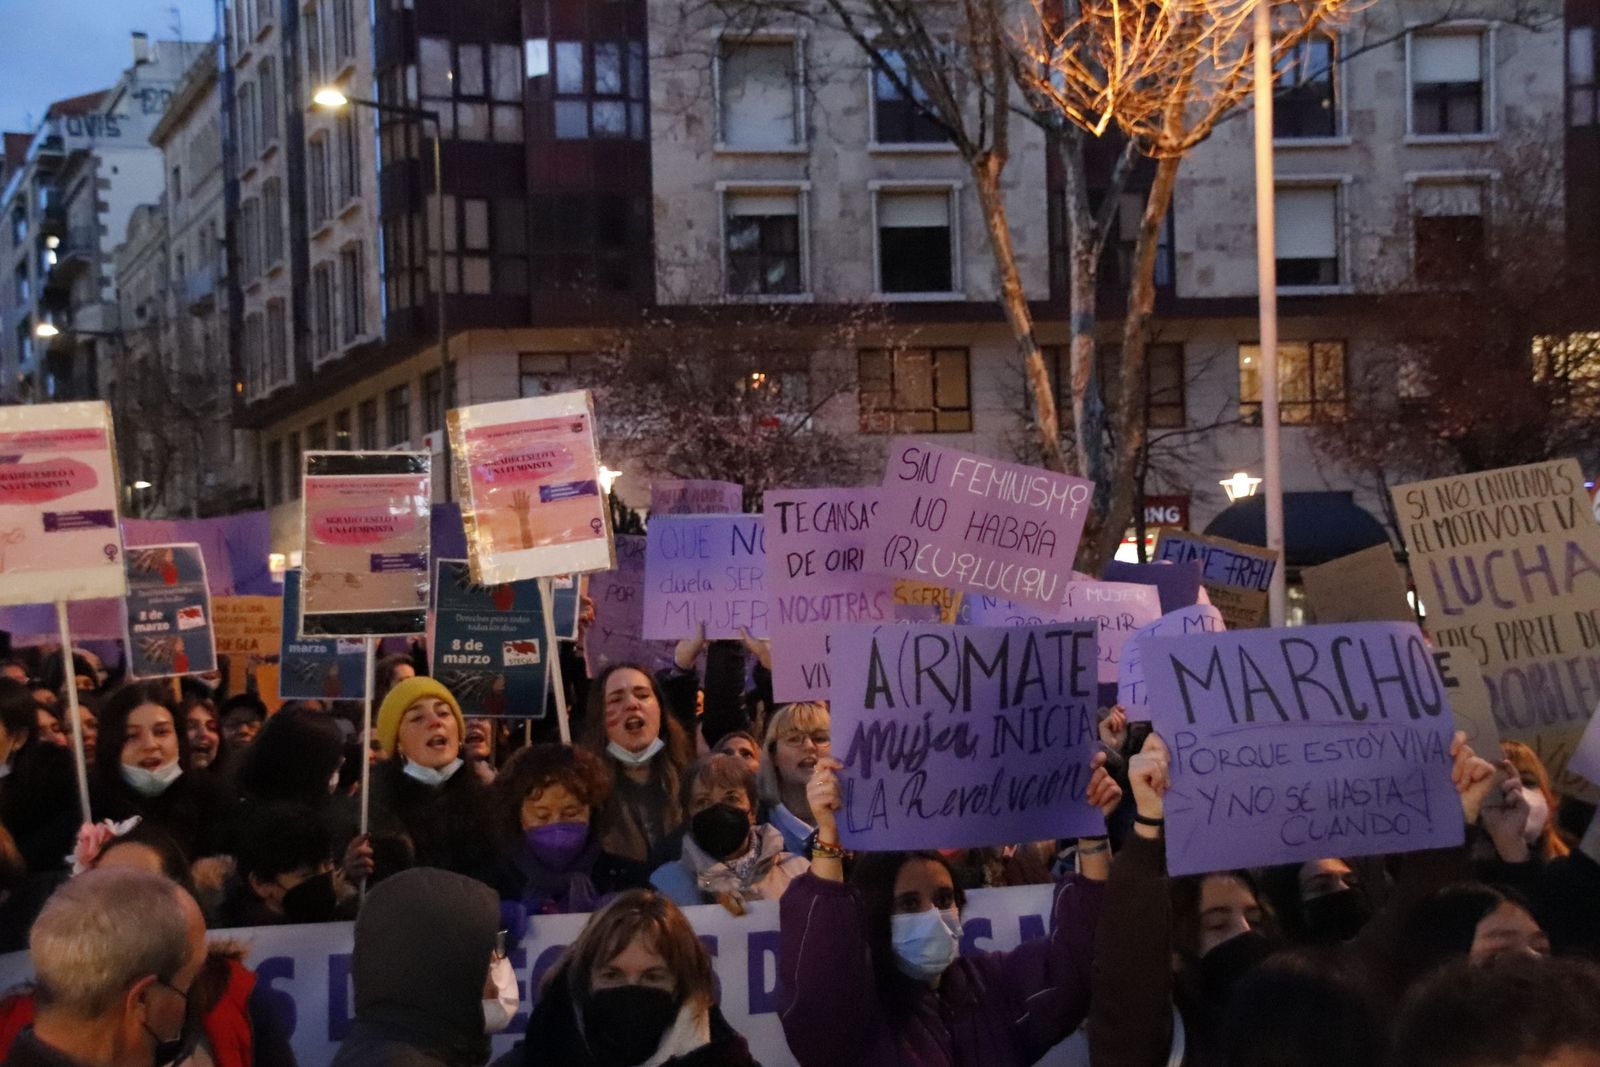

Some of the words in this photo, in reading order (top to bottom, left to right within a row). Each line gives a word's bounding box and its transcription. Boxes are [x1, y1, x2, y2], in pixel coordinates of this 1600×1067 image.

[899, 447, 942, 484] SIN
[1406, 490, 1430, 520] SI
[1475, 463, 1574, 506] ENTIENDES
[910, 496, 947, 533] NO
[964, 510, 1056, 558] HABRÍA
[1144, 505, 1181, 524] ING
[1411, 522, 1433, 554] EL
[1433, 503, 1518, 549] MOTIVO
[1519, 502, 1549, 534] DE
[660, 524, 710, 560] QUE
[660, 568, 712, 594] duela
[725, 566, 764, 592] SER
[787, 550, 816, 578] DE
[1225, 551, 1277, 593] FRAU
[1428, 540, 1600, 615] LUCHA
[605, 583, 635, 603] POR
[778, 591, 885, 625] NOSOTRAS
[1086, 587, 1147, 603] MUJER
[134, 621, 170, 632] marzo
[664, 600, 768, 631] MUJER
[289, 645, 328, 653] marzo
[452, 638, 461, 651] 8
[465, 638, 484, 651] de
[1495, 614, 1562, 661] PARTE
[443, 654, 491, 665] marzo
[1169, 634, 1442, 724] MARCHO
[1480, 655, 1600, 732] OBLE
[990, 703, 1095, 758] INICIA
[1174, 731, 1291, 776] PORQUE
[1304, 730, 1385, 764] ESTOY
[1390, 726, 1447, 764] VIVA
[847, 777, 889, 834] LA
[1199, 784, 1220, 825] Y
[1228, 784, 1275, 817] NO
[1327, 776, 1403, 811] HASTA
